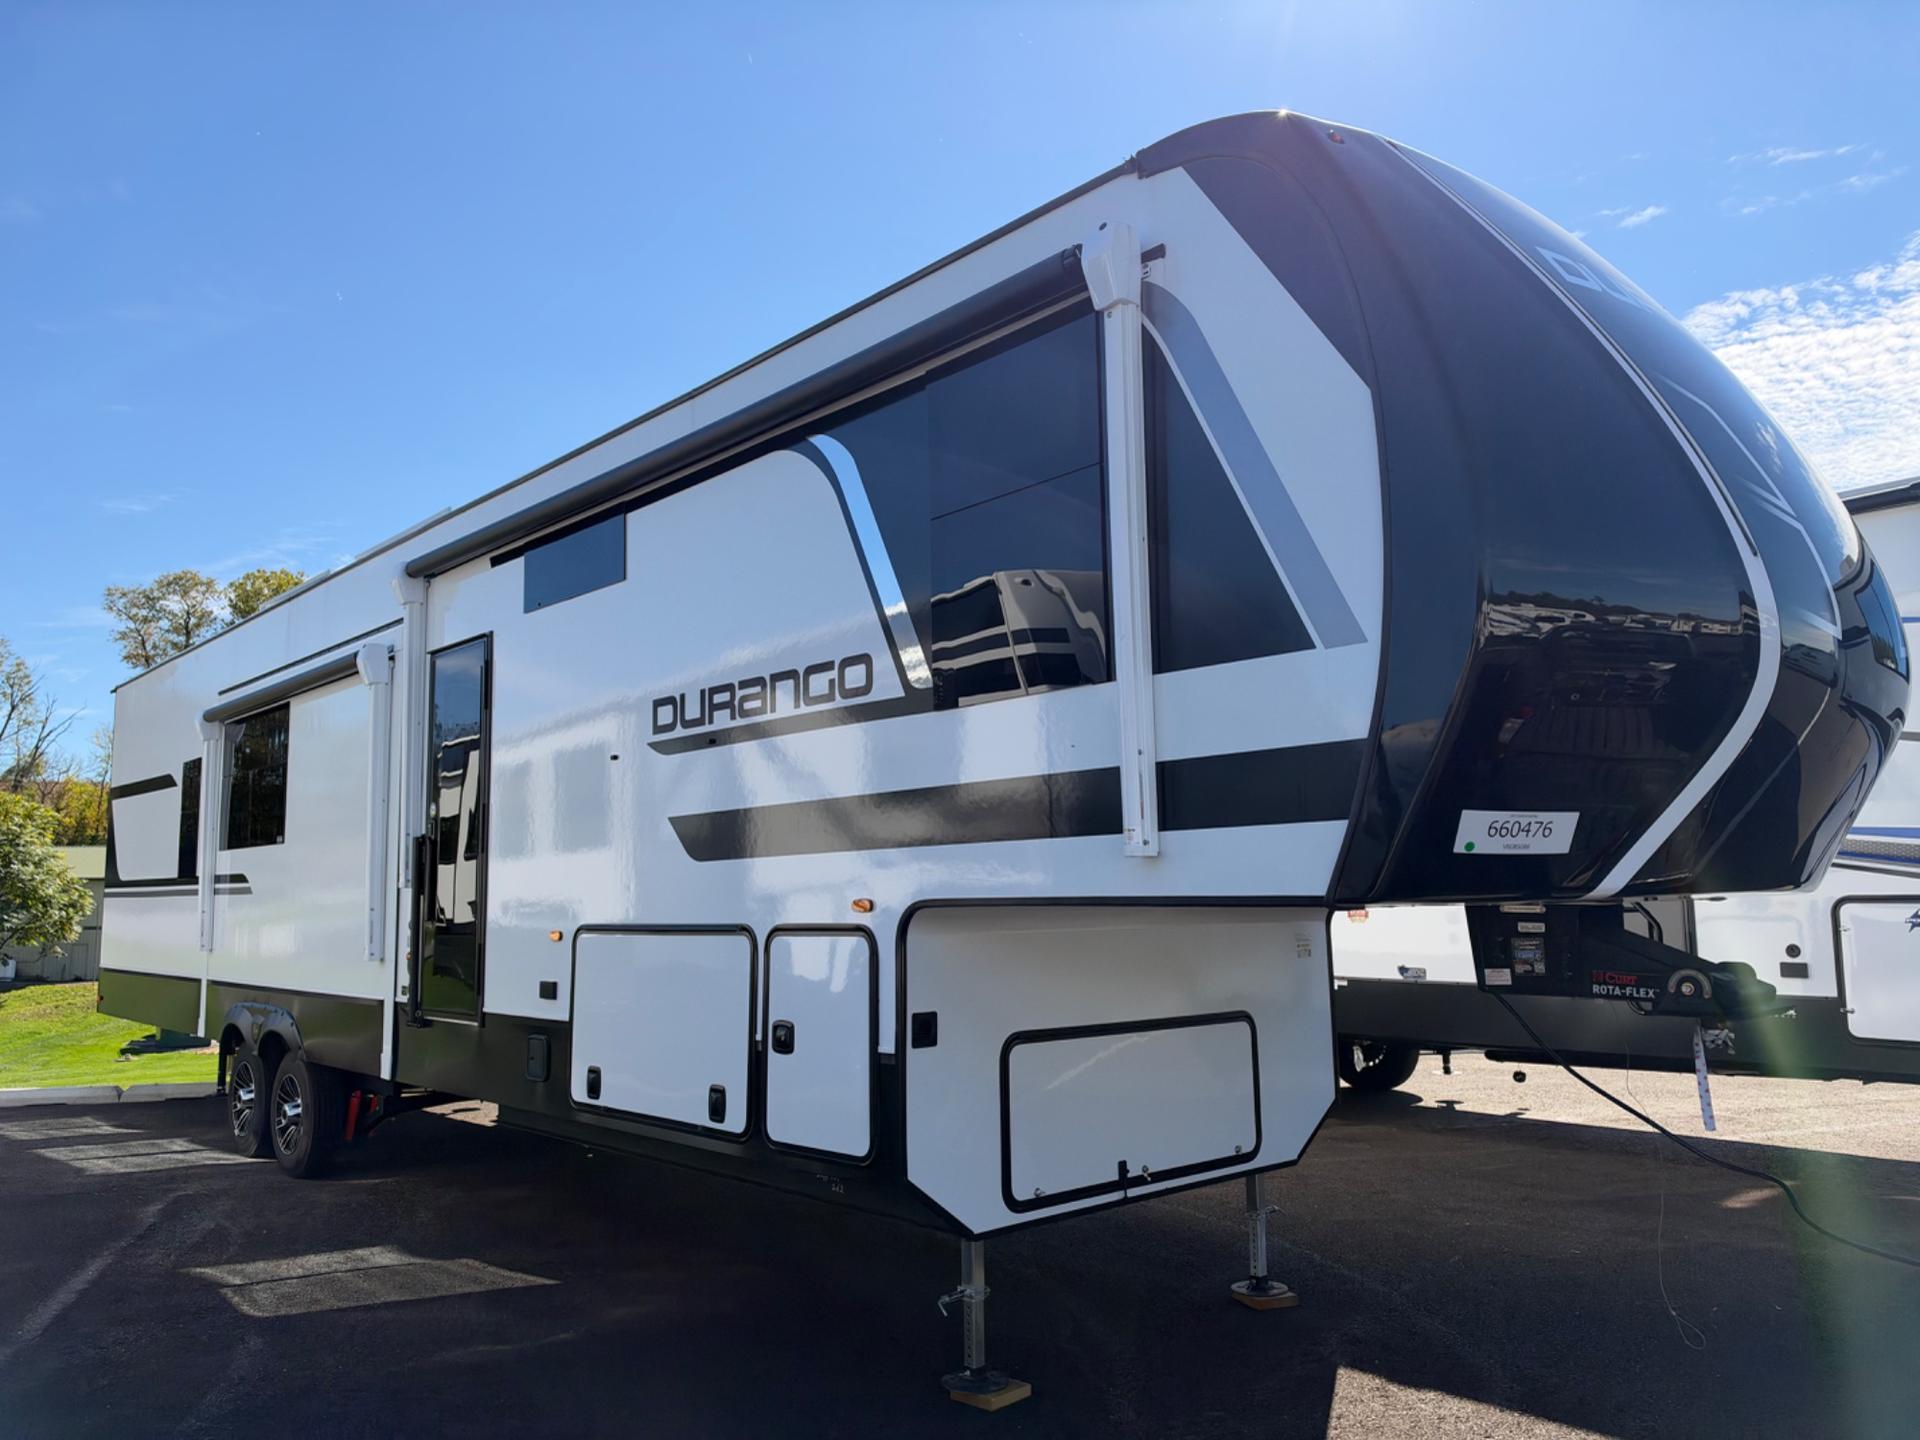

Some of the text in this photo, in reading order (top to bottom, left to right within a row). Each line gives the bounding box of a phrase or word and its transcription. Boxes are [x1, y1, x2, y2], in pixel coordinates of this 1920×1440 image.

[652, 653, 873, 736] DURANGO
[1487, 820, 1554, 838] 660476
[1592, 984, 1656, 999] ROTA-FLEX
